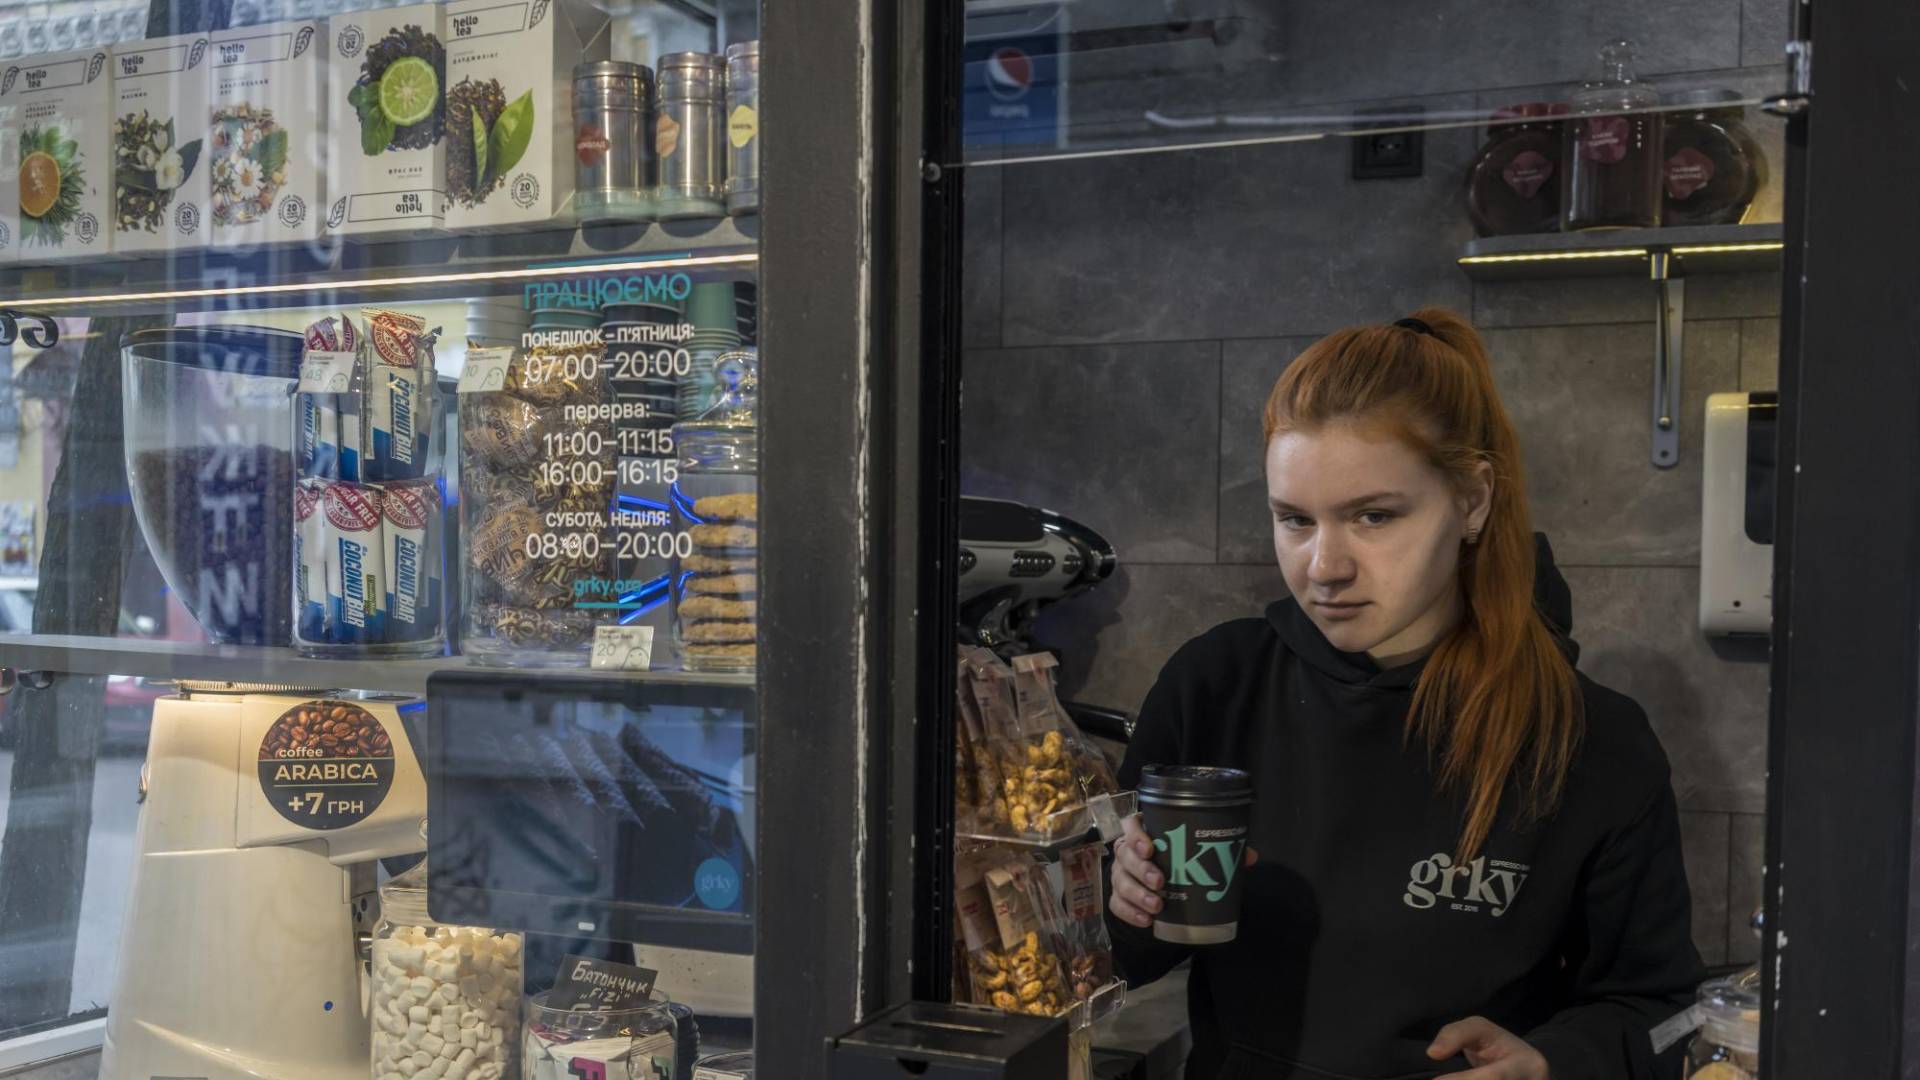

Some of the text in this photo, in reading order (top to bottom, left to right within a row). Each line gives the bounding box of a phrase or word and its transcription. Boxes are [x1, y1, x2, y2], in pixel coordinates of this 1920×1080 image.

[453, 15, 478, 29] hello
[457, 26, 471, 36] tea
[219, 43, 244, 55] hello
[121, 54, 144, 67] hello
[222, 54, 238, 63] tea
[26, 70, 47, 80] hello
[124, 65, 138, 74] tea
[28, 79, 41, 88] tea
[519, 182, 531, 192] 20
[402, 193, 419, 203] tea
[182, 210, 192, 220] 20
[286, 203, 298, 213] 20
[396, 202, 422, 214] hello
[524, 273, 692, 311] ПРАЦЮЄМО
[522, 329, 603, 348] ПОНЕДІЛОК
[564, 403, 650, 424] перерва:
[354, 502, 377, 527] FREE
[546, 510, 670, 529] СУБОТА, НЕДІЛЯ:
[344, 540, 363, 603] COCONUT
[399, 536, 416, 600] COCONUT
[574, 574, 641, 597] grky.org
[346, 599, 365, 628] BAR
[399, 595, 416, 624] BAR
[279, 746, 324, 758] coffee
[274, 763, 378, 781] ARABICA
[288, 792, 364, 815] +7 ГРН
[701, 874, 733, 894] grky
[1403, 852, 1528, 917] grky
